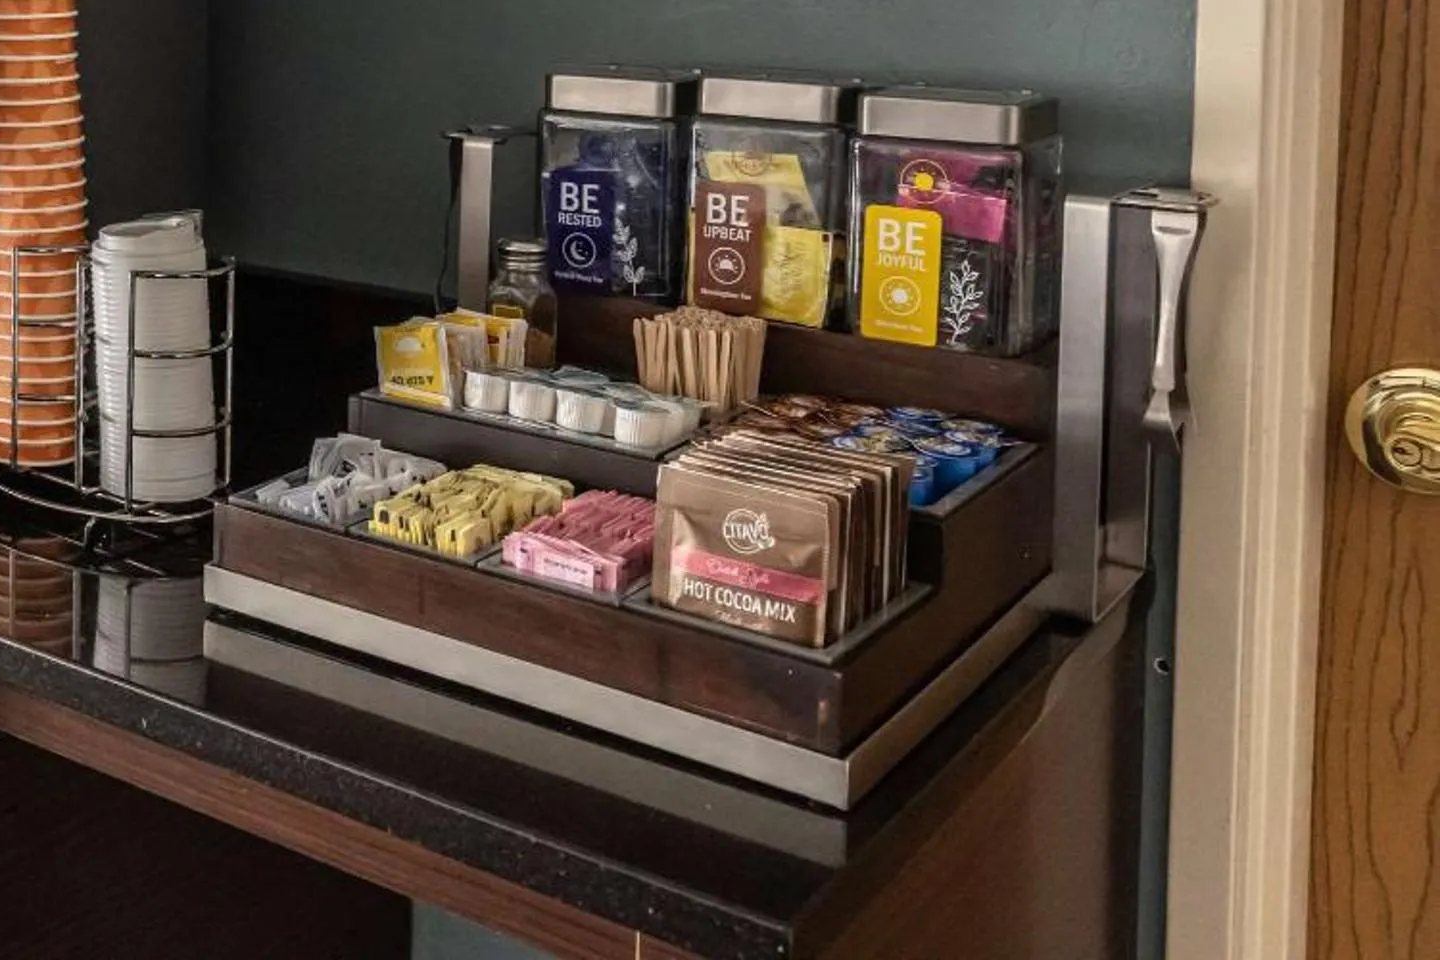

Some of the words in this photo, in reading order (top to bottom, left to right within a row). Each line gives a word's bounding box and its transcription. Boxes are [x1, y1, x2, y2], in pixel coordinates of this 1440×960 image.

[560, 181, 600, 214] BE
[706, 191, 750, 228] BE
[557, 211, 602, 228] RESTED
[702, 223, 753, 243] UPBEAT
[878, 218, 928, 256] BE
[875, 250, 927, 273] JOYFUL
[683, 577, 714, 602] HOT
[714, 586, 762, 615] COCOA
[764, 598, 797, 624] MIX
